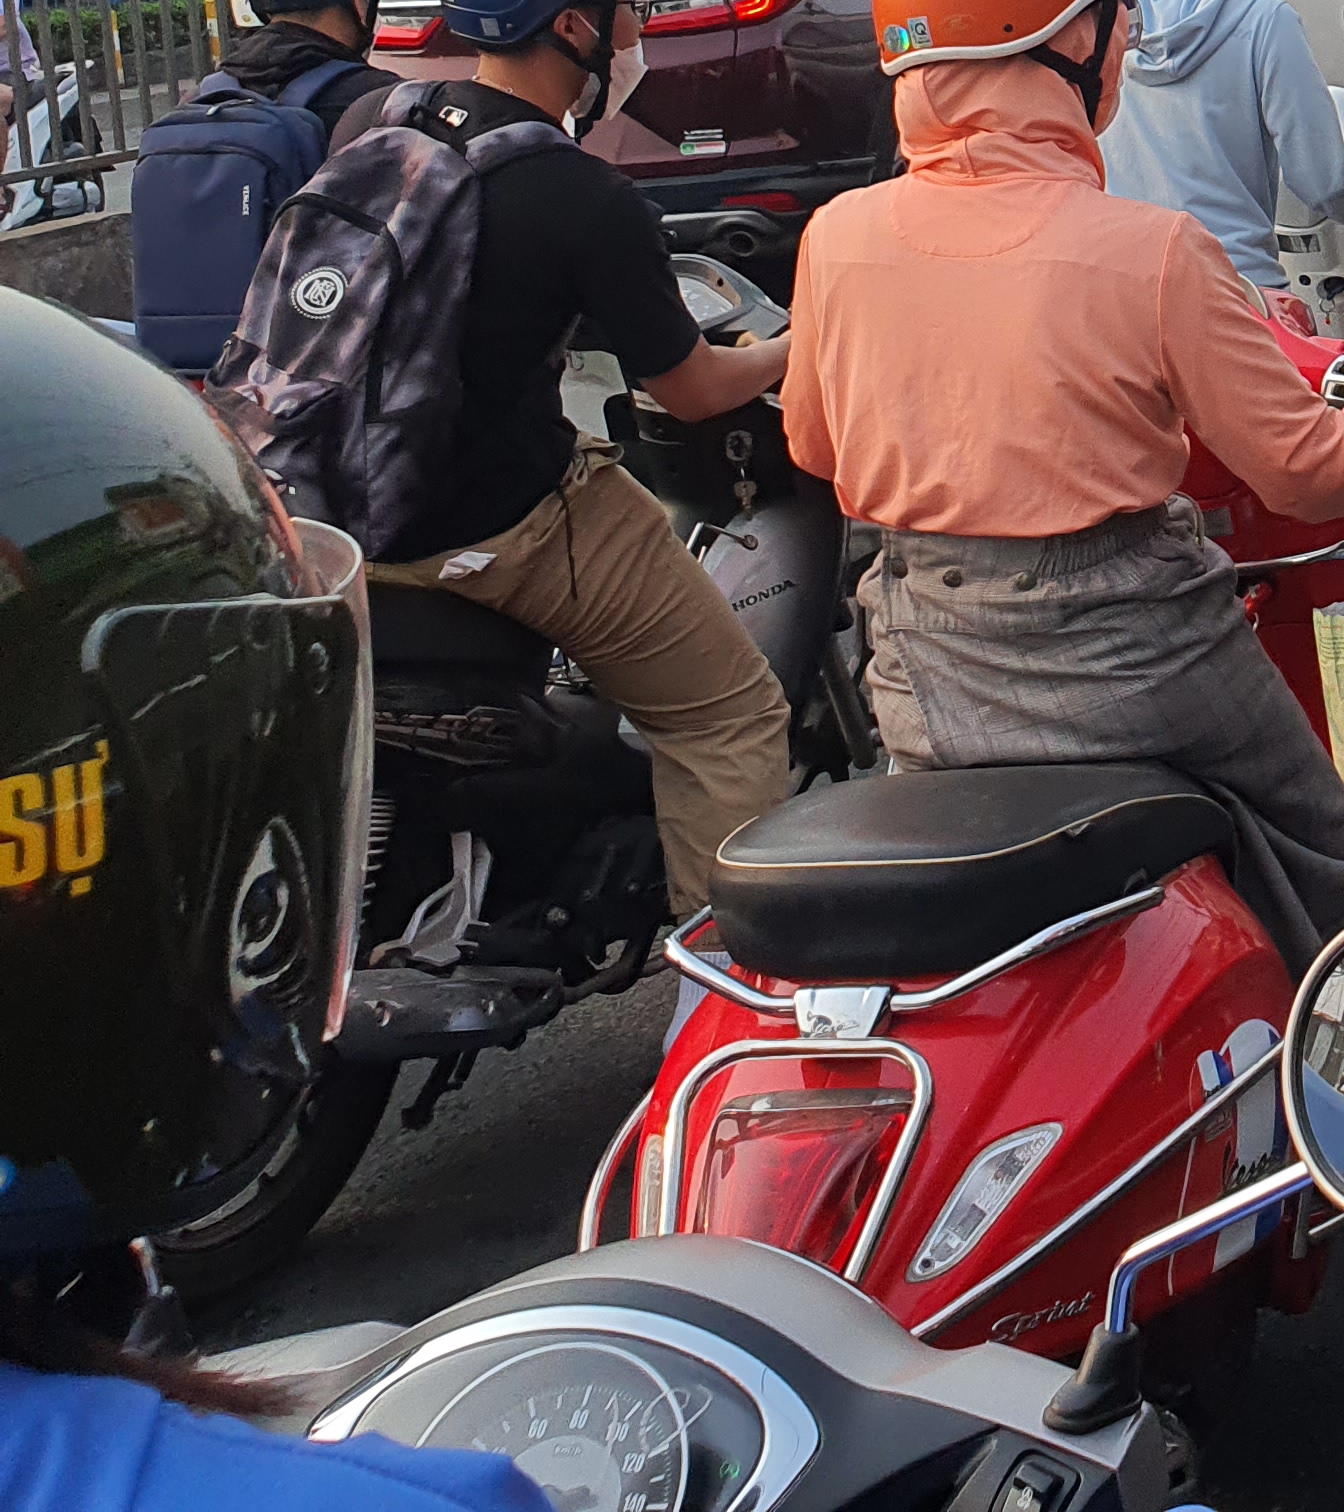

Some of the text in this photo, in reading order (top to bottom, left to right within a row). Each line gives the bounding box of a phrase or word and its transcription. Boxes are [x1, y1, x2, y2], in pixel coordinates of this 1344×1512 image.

[732, 579, 797, 612] HONDA
[528, 1419, 549, 1439] 60
[569, 1409, 590, 1430] 80
[621, 1452, 647, 1473] 120
[624, 1492, 648, 1512] 140
